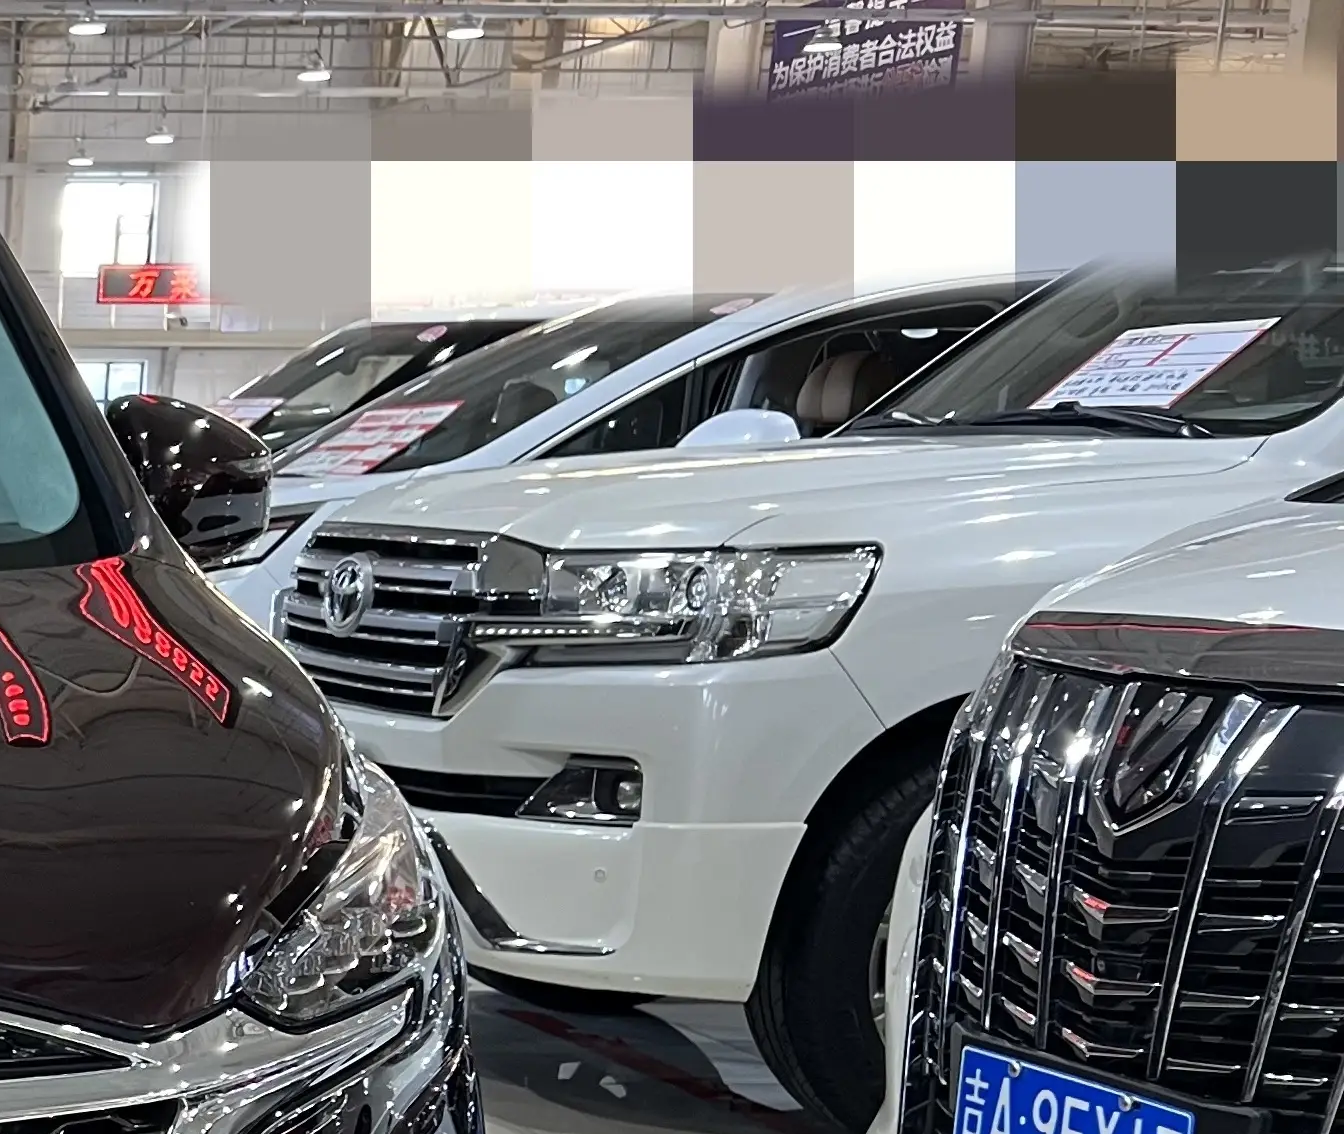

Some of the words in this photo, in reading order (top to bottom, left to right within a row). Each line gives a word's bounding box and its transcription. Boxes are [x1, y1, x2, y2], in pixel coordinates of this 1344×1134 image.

[771, 21, 957, 91] 为保护消费者合法权益
